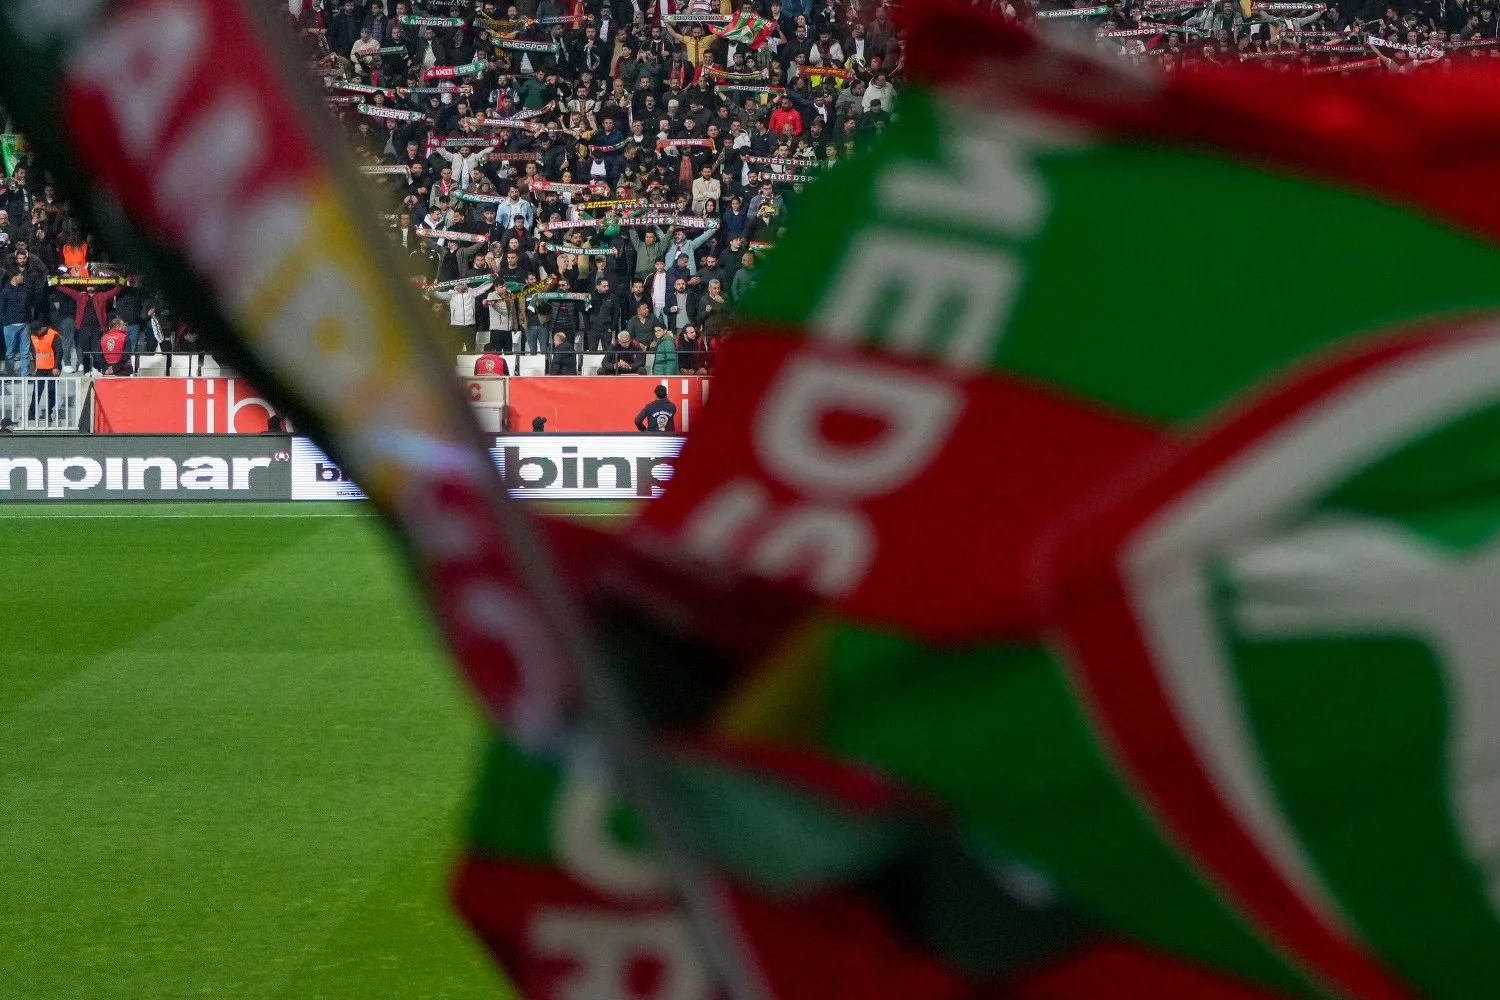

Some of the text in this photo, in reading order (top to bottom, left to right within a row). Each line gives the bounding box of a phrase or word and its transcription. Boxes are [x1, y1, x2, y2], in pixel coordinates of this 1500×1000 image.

[1048, 9, 1096, 17] AMEDSPOR
[502, 42, 548, 52] AMEDSPOR
[436, 67, 476, 77] AMED SPOR
[366, 107, 409, 120] AMEDSPOR
[485, 119, 525, 127] AMEDSPOR
[756, 158, 812, 166] AMEDSPOR
[548, 219, 597, 229] AMEDSPOR
